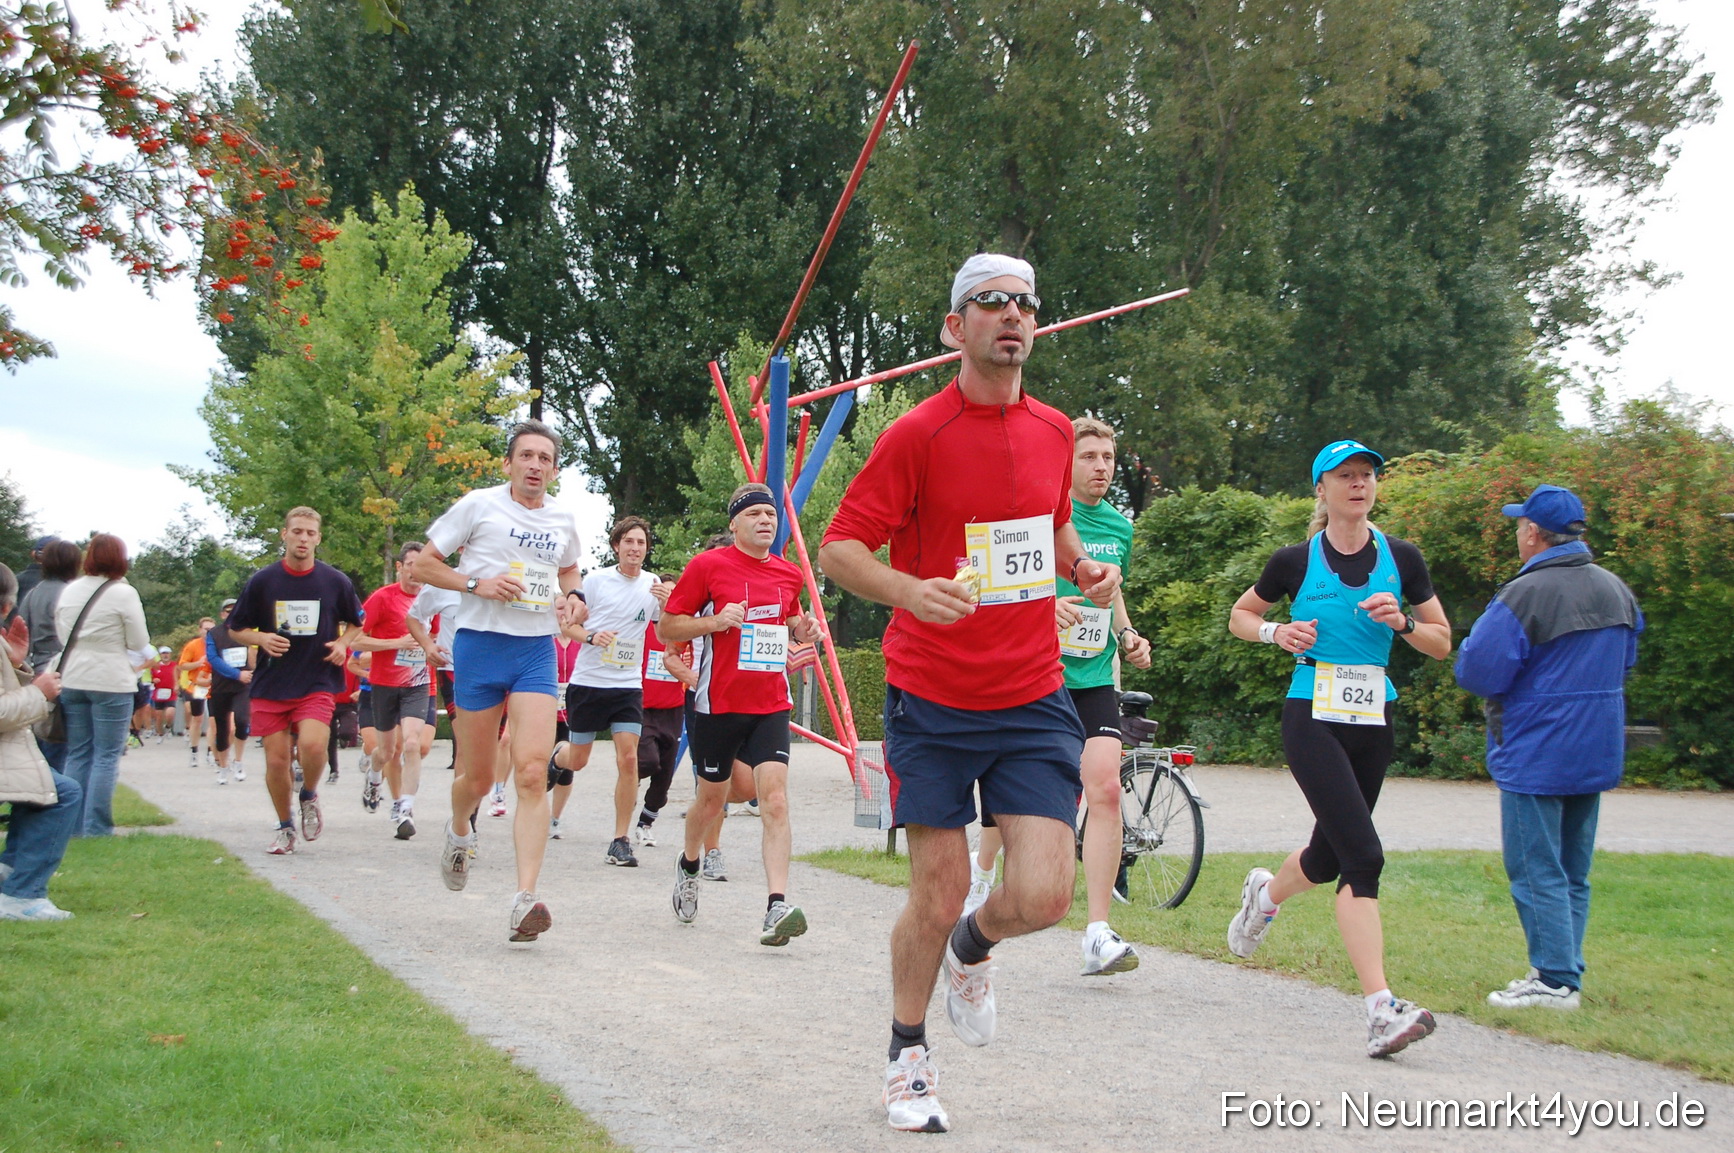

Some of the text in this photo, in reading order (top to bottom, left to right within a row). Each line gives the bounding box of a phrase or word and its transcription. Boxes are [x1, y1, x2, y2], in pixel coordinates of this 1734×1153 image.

[510, 527, 551, 541] Lauf
[993, 528, 1029, 545] Simon
[519, 535, 557, 551] Treff
[1083, 541, 1119, 557] upret
[971, 555, 978, 567] B
[1005, 549, 1043, 575] 578
[525, 567, 548, 580] Jürgen
[529, 582, 550, 597] 706
[1315, 581, 1326, 589] LG
[1306, 592, 1338, 602] Heideck
[295, 614, 309, 624] 63
[1080, 611, 1100, 622] arald
[756, 628, 777, 638] Robert
[1077, 627, 1101, 642] 216
[617, 650, 635, 660] 502
[756, 642, 783, 656] 2323
[1336, 667, 1368, 682] Sabine
[1342, 686, 1374, 706] 624
